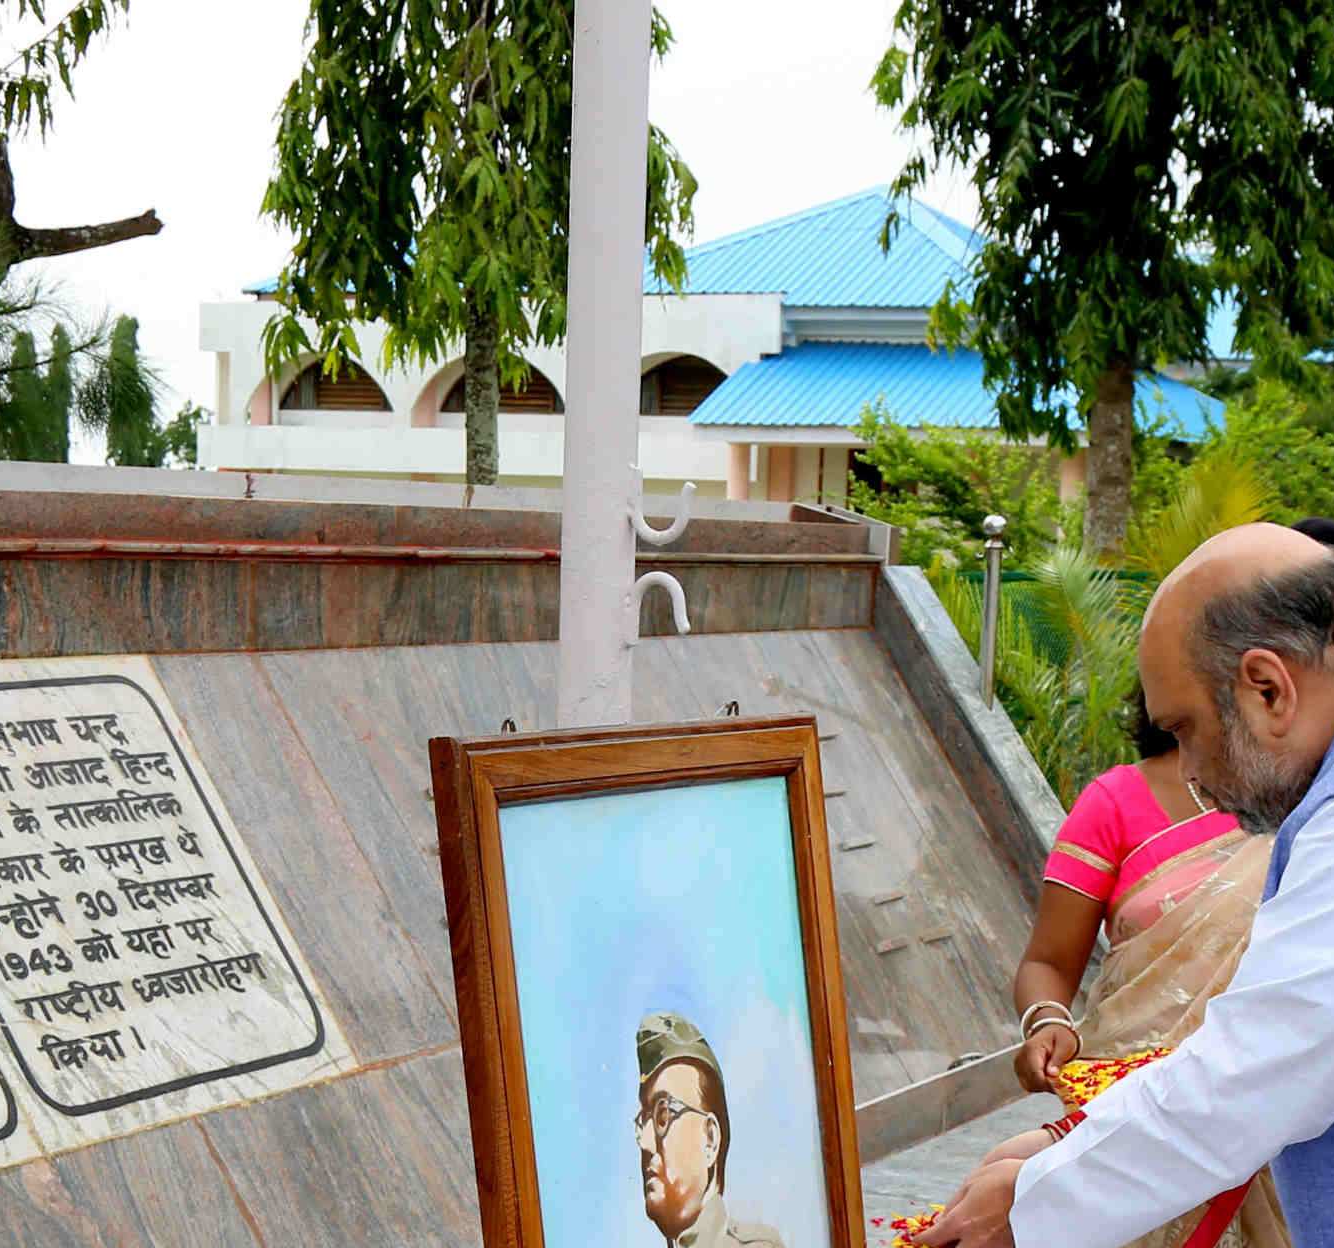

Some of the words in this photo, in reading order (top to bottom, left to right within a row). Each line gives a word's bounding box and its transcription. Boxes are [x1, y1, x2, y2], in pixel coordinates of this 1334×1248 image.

[65, 714, 129, 746] चन्द्र
[25, 758, 113, 789] आजाद
[110, 748, 176, 784] हिन्द
[7, 800, 41, 834] के
[46, 789, 182, 829] तात्कालिक
[49, 841, 85, 874] के
[85, 836, 171, 874] प्रमुख
[177, 826, 204, 858] थे
[76, 890, 117, 921] 30
[117, 873, 220, 913] दिसम्बर
[74, 928, 120, 963] को
[175, 917, 223, 945] पर
[14, 980, 125, 1023] राष्ट्रीय
[131, 952, 267, 1001] ध्वजारोहण
